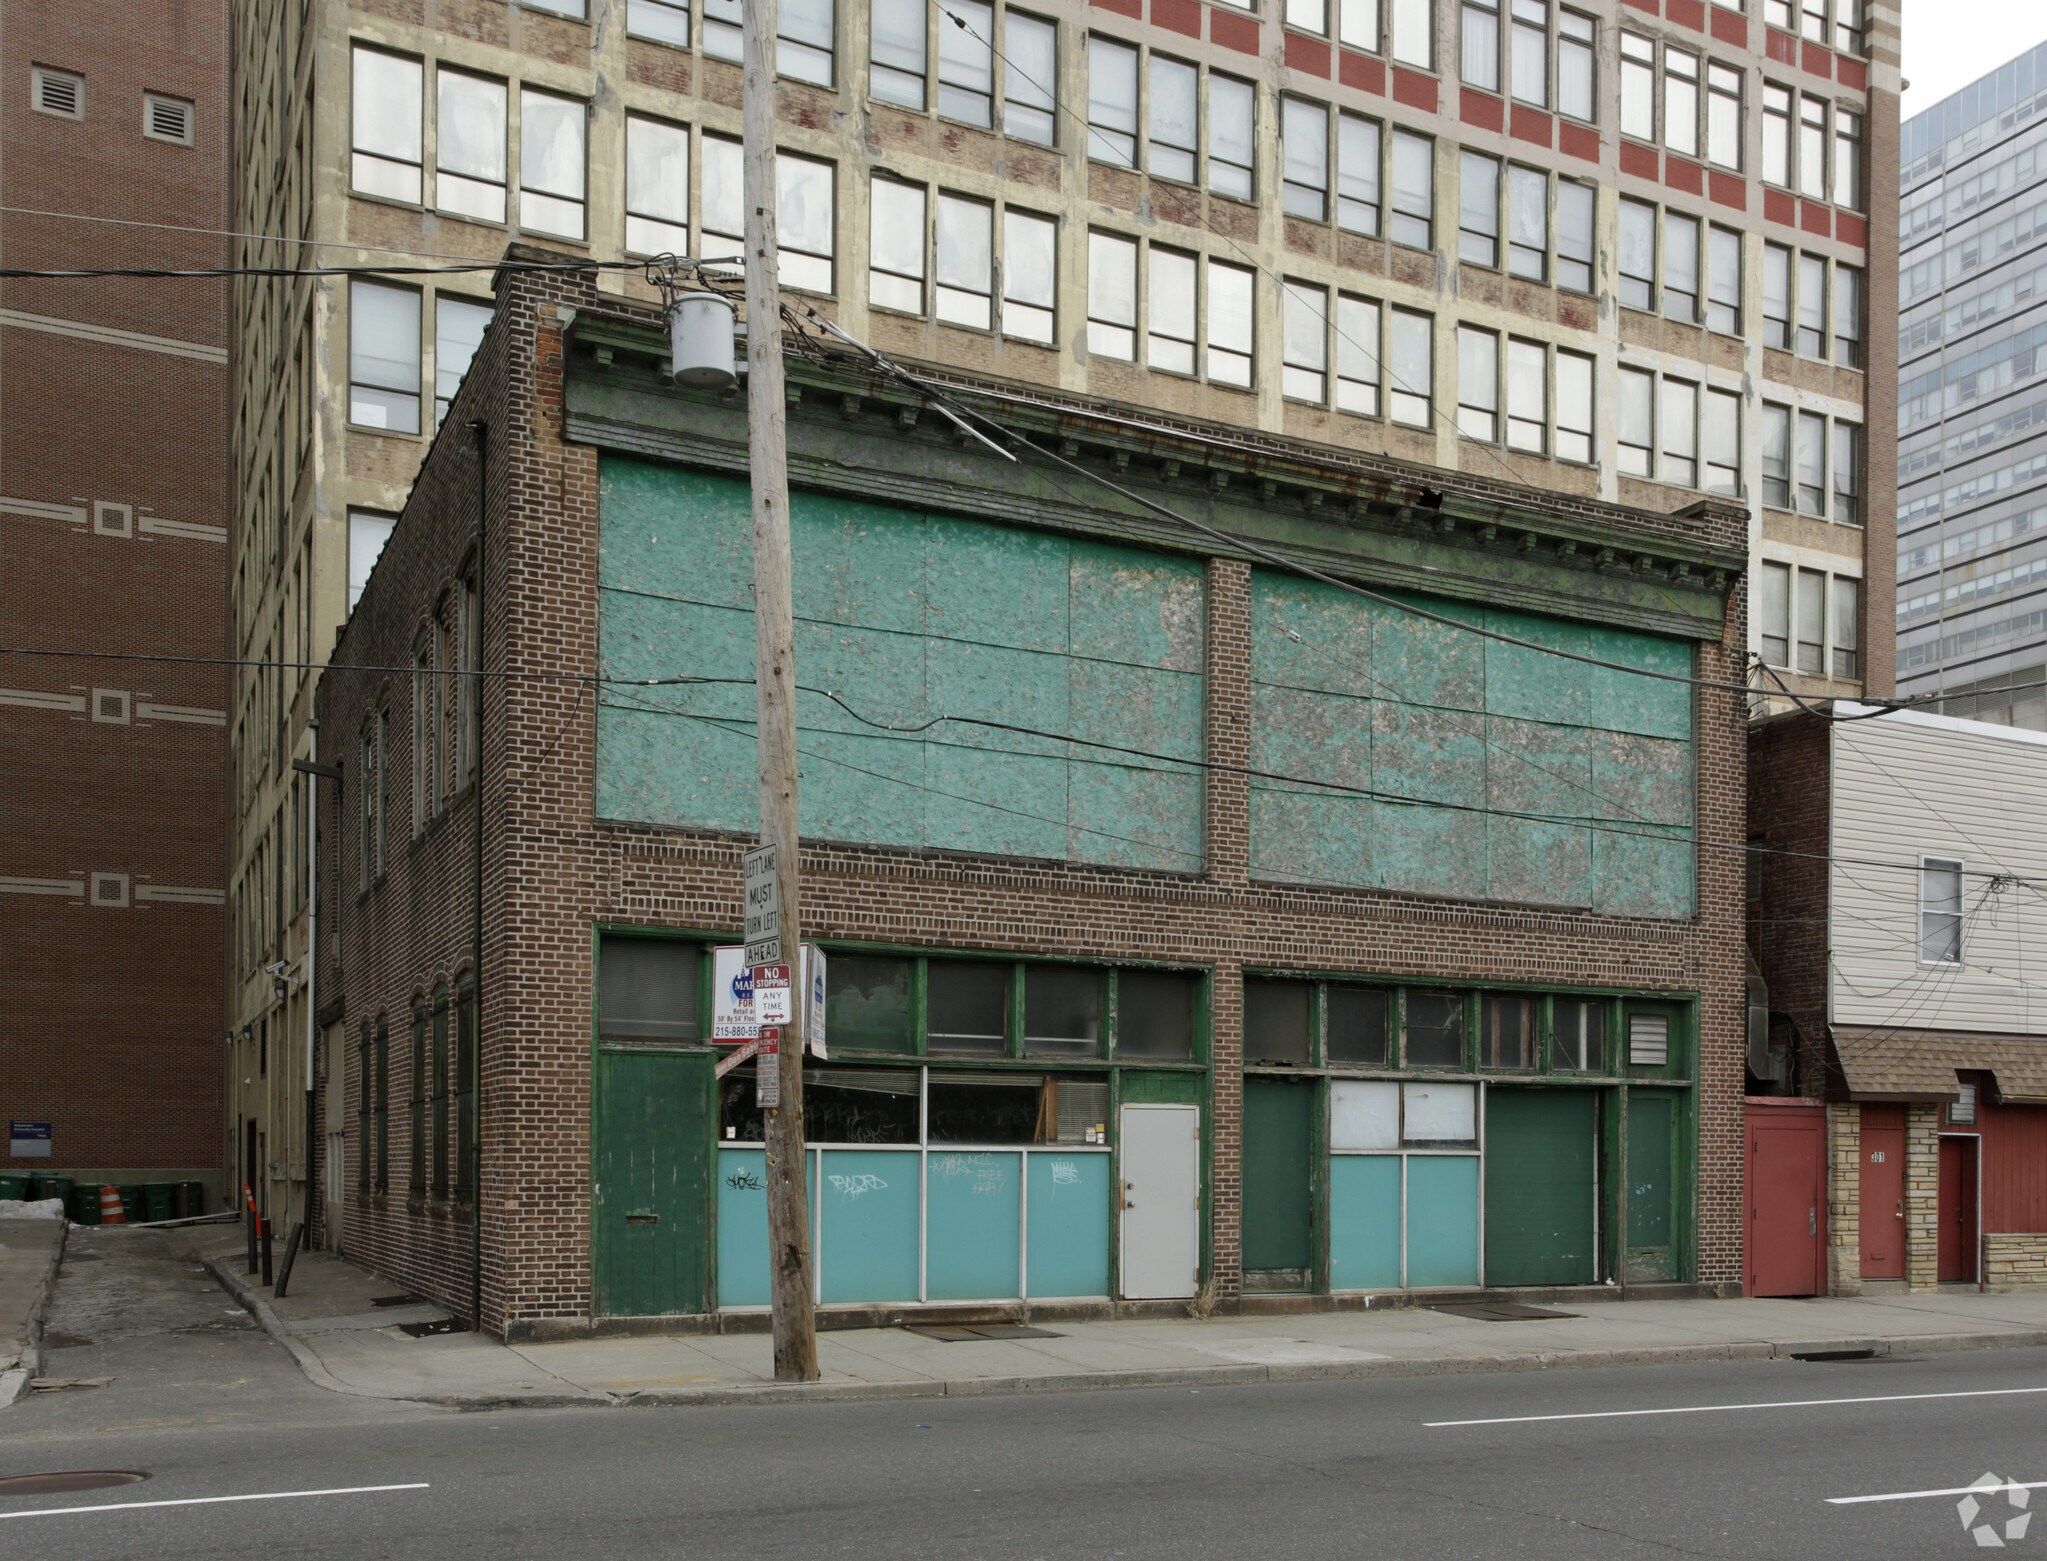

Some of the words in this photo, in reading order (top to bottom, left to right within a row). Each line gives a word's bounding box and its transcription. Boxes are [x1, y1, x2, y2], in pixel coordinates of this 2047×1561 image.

[746, 858, 758, 879] LEFT
[761, 853, 776, 874] LANE
[750, 883, 772, 906] MUST
[747, 916, 761, 936] TURN
[764, 911, 777, 931] LEFT
[748, 943, 777, 962] AHEAD
[764, 967, 779, 979] NO
[756, 979, 789, 988] STOPPING
[762, 1002, 783, 1010] TIME
[727, 1016, 733, 1024] By
[1871, 1152, 1884, 1162] 301
